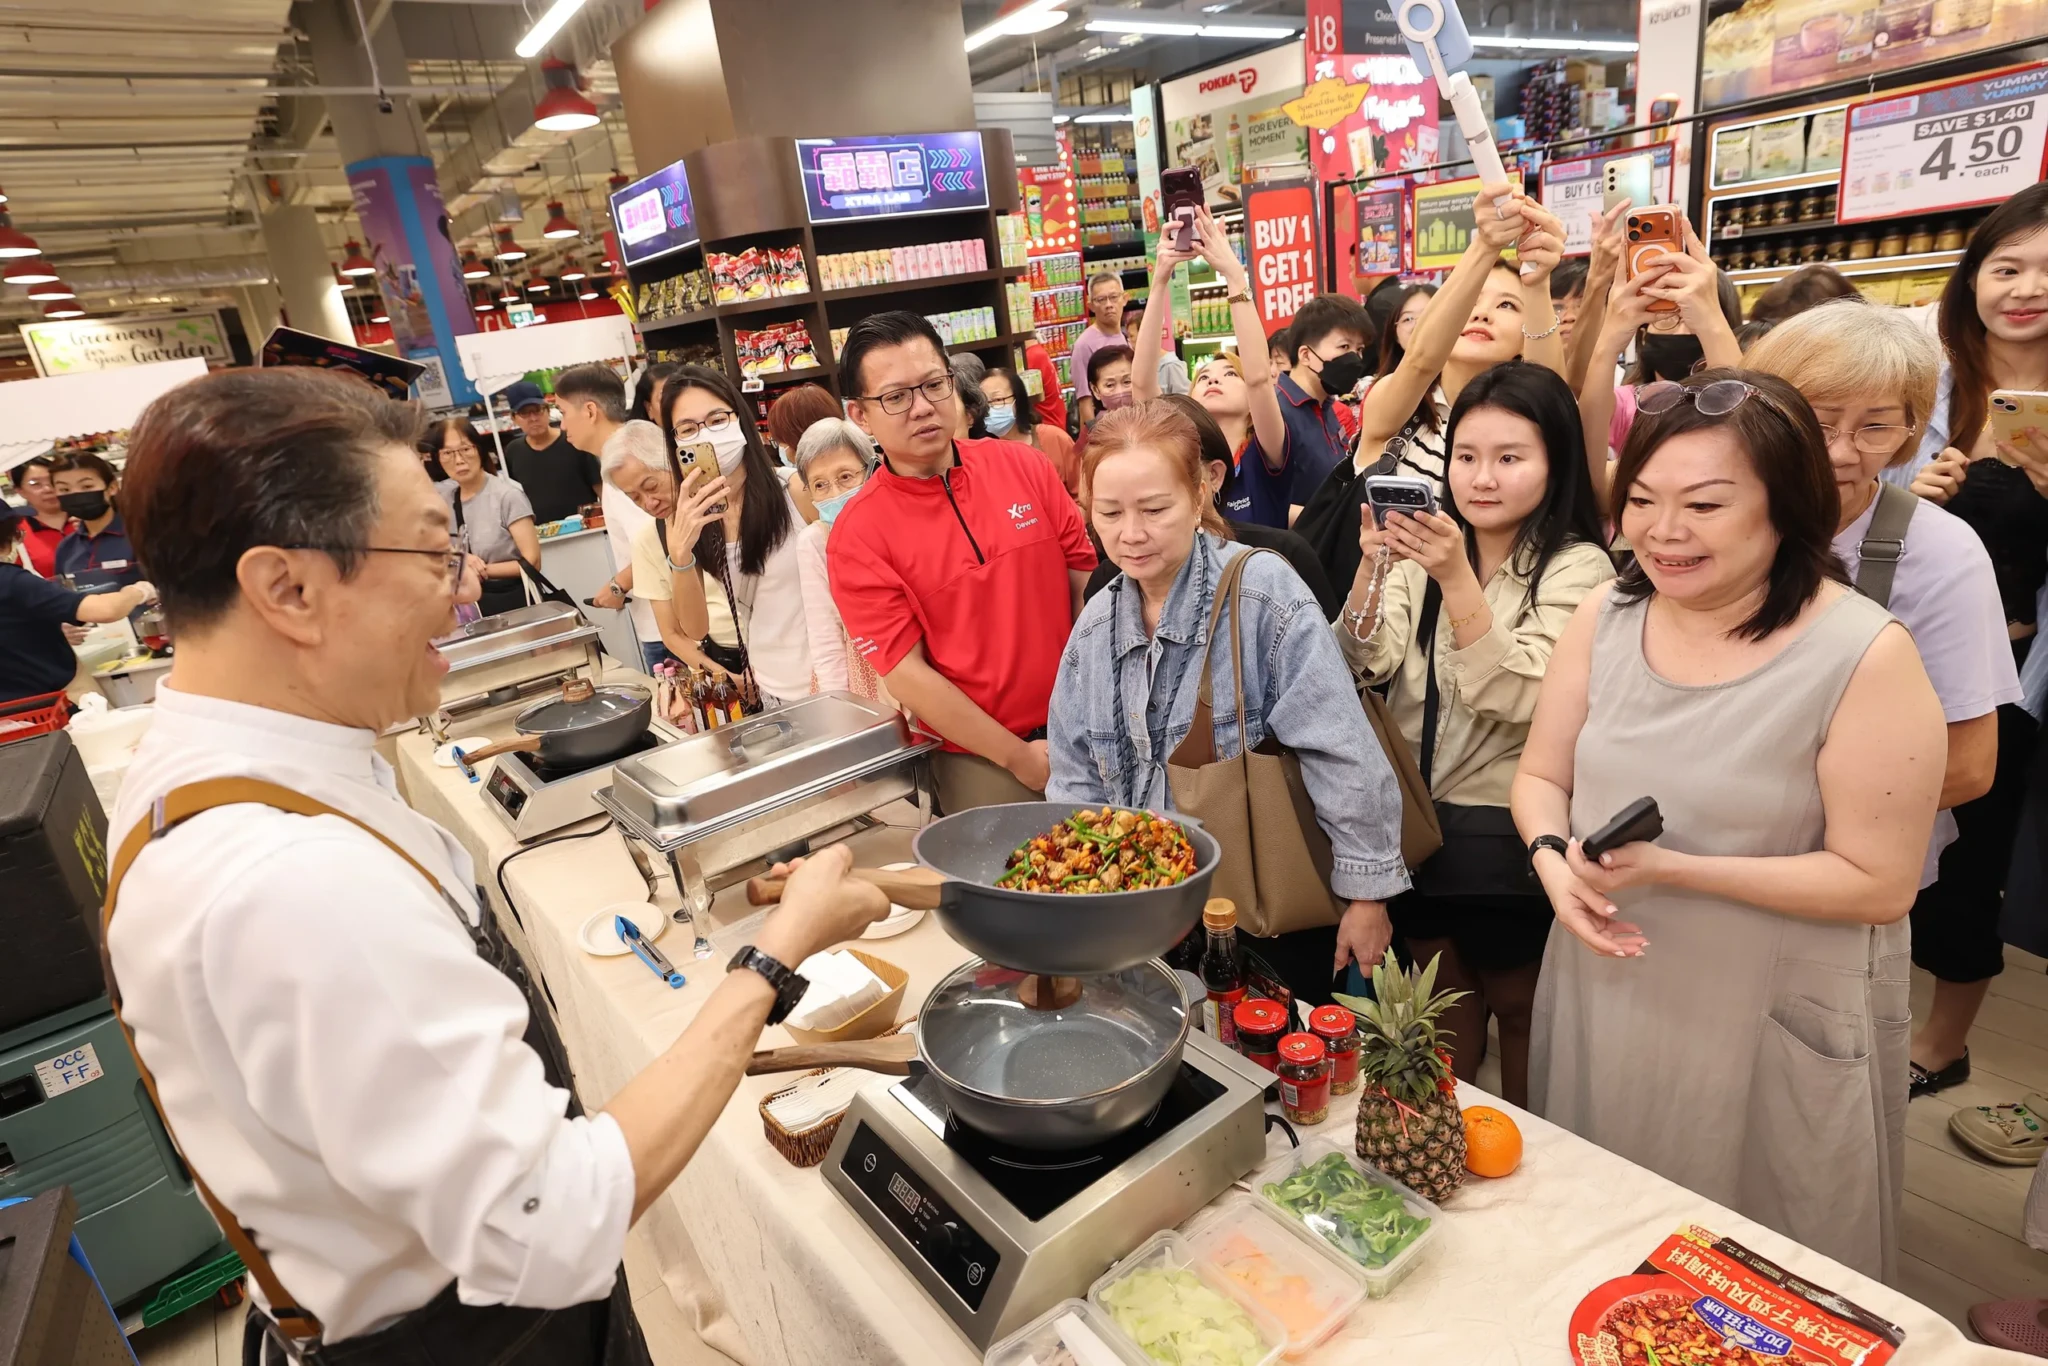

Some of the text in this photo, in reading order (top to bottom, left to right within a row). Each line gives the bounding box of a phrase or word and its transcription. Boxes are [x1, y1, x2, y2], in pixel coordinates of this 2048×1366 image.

[1314, 15, 1337, 52] 18
[1365, 32, 1397, 45] Preserved
[1199, 73, 1237, 94] POKKA
[1982, 80, 2048, 100] YUMMY
[1983, 70, 2048, 90] YUMMY
[1249, 121, 1266, 135] FOR
[1266, 115, 1296, 131] EVERY
[1917, 103, 2030, 138] SAVE $1.40
[1249, 130, 1287, 148] MOMENT
[820, 150, 925, 192] 霸霸店
[1974, 164, 2009, 179] each
[844, 192, 912, 208] XTRA LAB
[1565, 181, 1583, 199] BUY
[1587, 184, 1592, 197] 1
[1254, 214, 1312, 250] BUY 1
[1258, 248, 1314, 286] GET 1
[1263, 281, 1315, 321] FREE
[70, 325, 164, 346] Greenery
[131, 340, 215, 364] Garden
[1007, 503, 1032, 520] Xtra
[1227, 496, 1250, 508] FairPrice
[1015, 517, 1038, 530] Dewen
[53, 1050, 85, 1070] OCC
[922, 1211, 931, 1221] TEMP
[926, 1201, 940, 1216] HEATING
[917, 1221, 928, 1232] TIMER
[1665, 1246, 1869, 1362] 重庆辣子鸡风味调料
[1700, 1298, 1791, 1352] 加点滋味
[1753, 1339, 1784, 1356] TASTE
